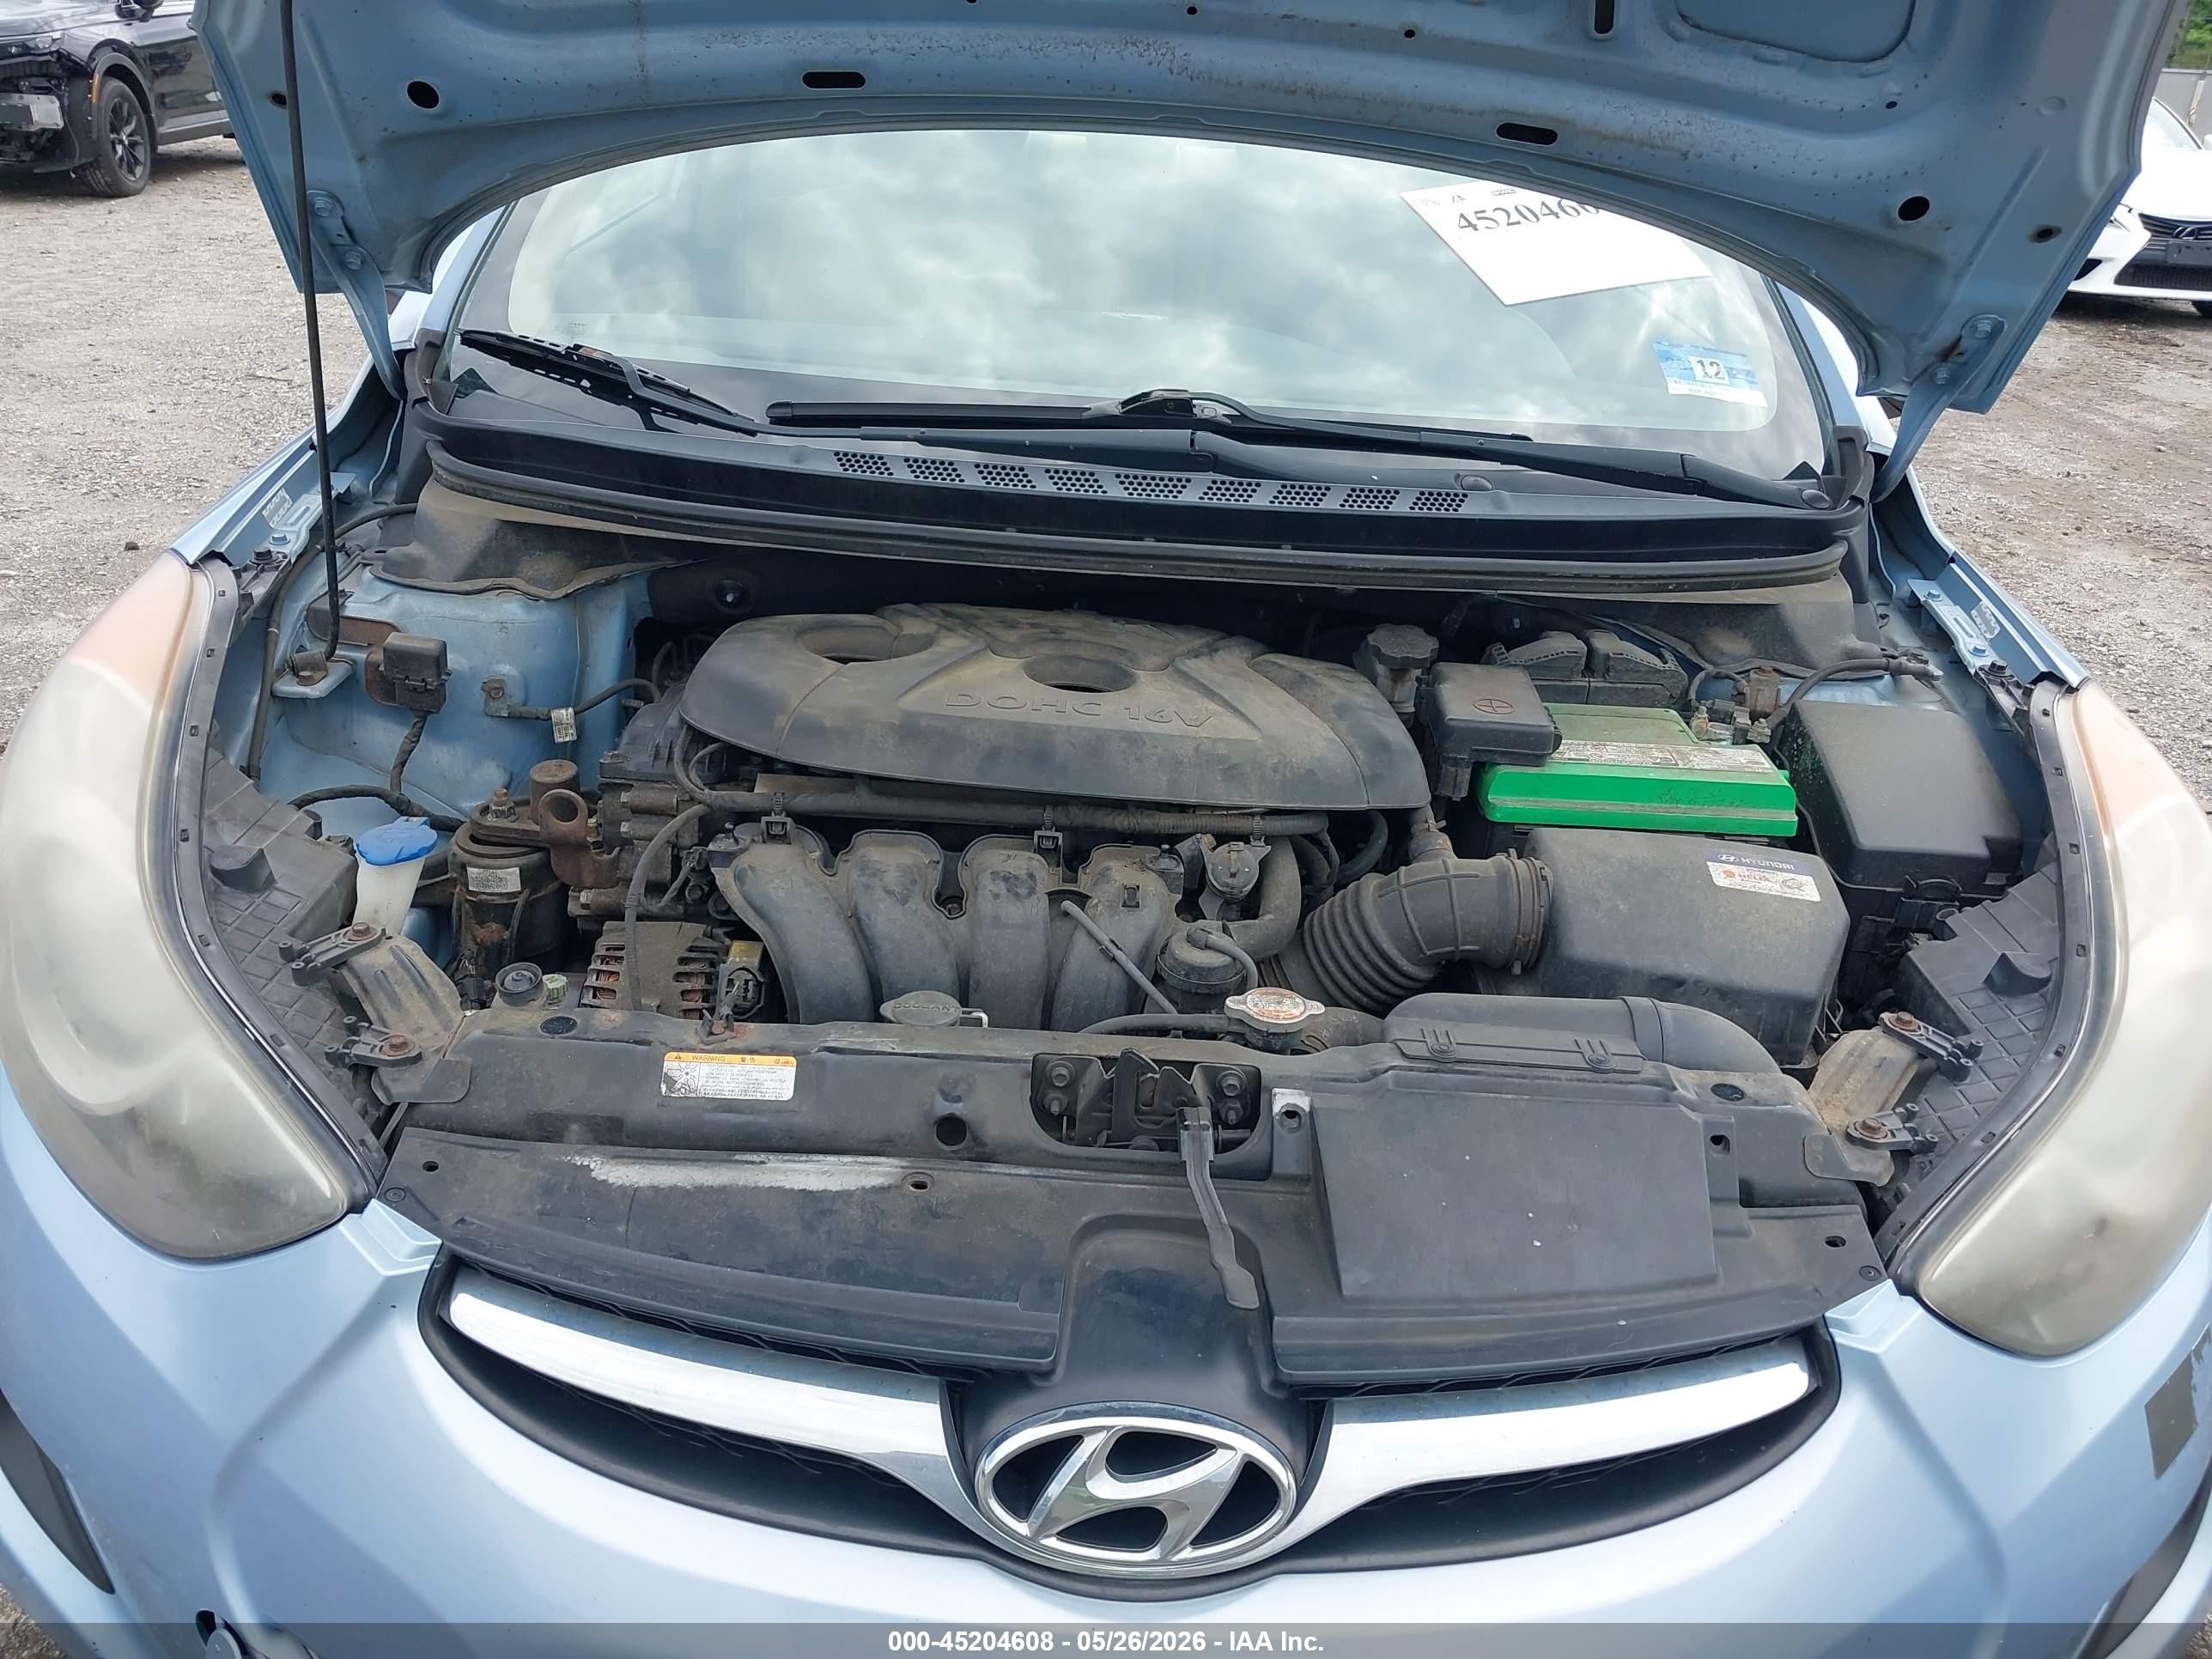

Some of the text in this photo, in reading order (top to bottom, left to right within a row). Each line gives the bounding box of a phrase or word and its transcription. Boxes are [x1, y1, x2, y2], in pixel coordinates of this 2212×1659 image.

[1697, 360, 1725, 380] 12
[946, 693, 1213, 728] DOHC 16V
[1741, 857, 1796, 871] HYUNDAI
[893, 1002, 961, 1012] COOLANT
[691, 1054, 726, 1062] WARNING
